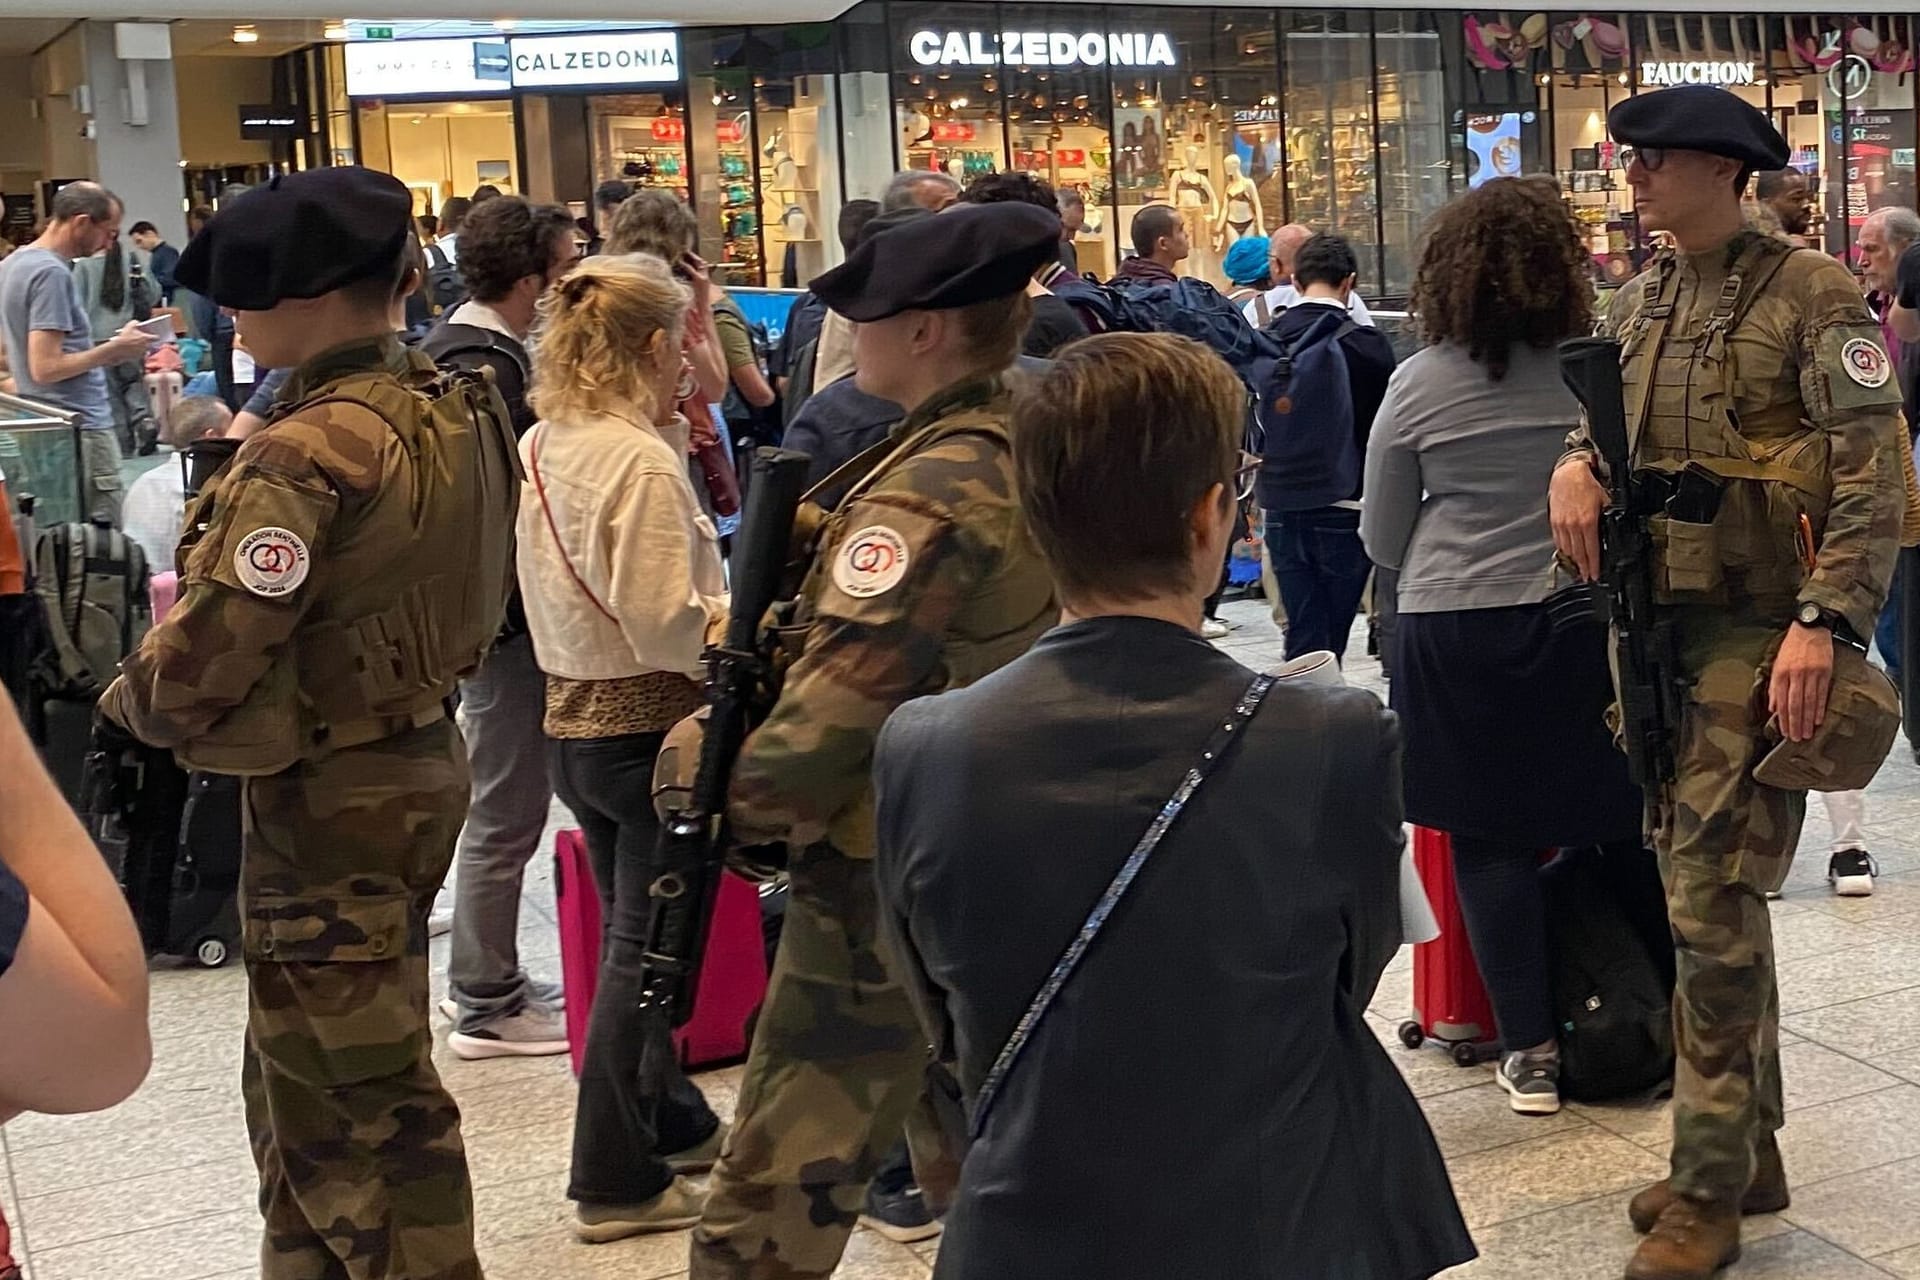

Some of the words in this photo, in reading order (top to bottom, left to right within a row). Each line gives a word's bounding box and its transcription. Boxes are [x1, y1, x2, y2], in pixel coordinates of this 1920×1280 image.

[515, 48, 675, 72] CALZEDONIA
[910, 31, 1176, 66] CALZEDONIA
[1641, 61, 1755, 85] FAUCHON
